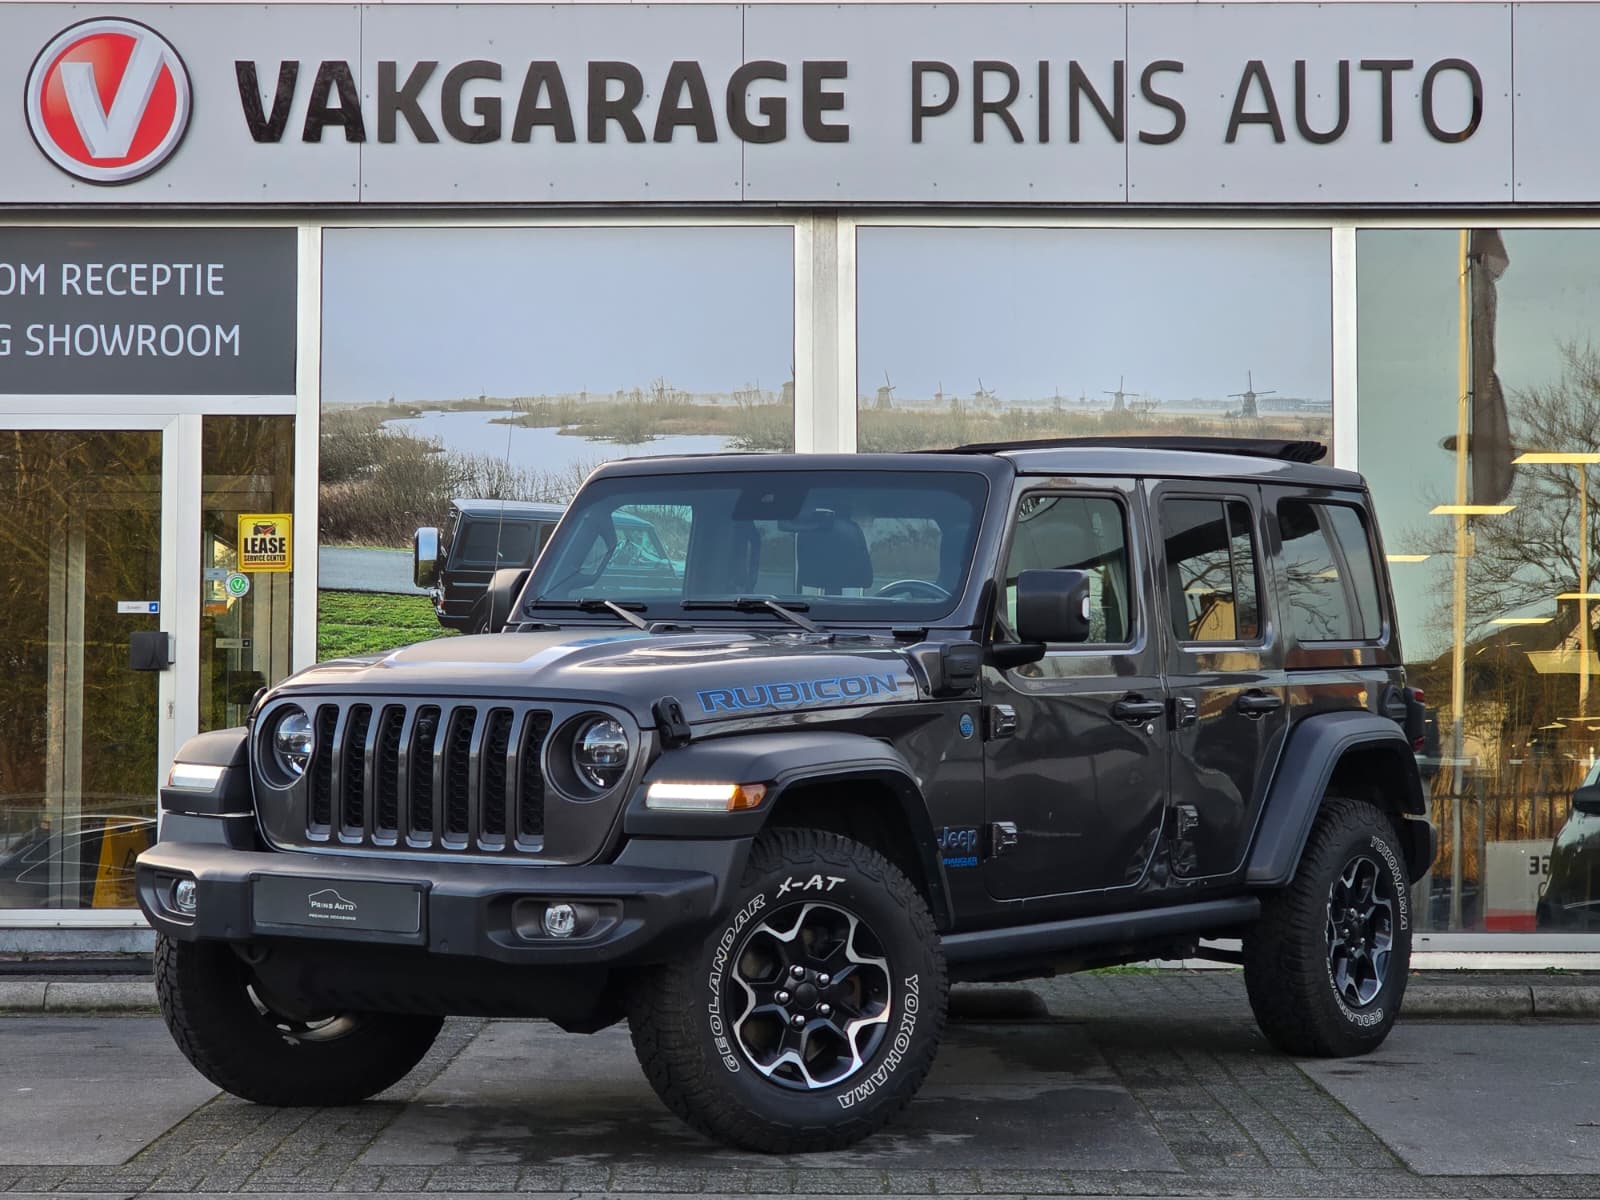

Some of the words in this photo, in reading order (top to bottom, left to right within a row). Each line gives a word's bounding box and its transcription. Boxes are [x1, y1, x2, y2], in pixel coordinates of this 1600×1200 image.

[234, 59, 850, 143] VAKGARAGE
[911, 59, 1187, 144] PRINS
[1224, 58, 1484, 144] AUTO
[61, 263, 225, 296] RECEPTIE
[25, 323, 241, 357] SHOWROOM
[243, 537, 286, 554] LEASE
[243, 554, 265, 562] SERVICE
[697, 672, 899, 713] RUBICON
[936, 825, 977, 852] Jeep
[708, 893, 766, 1073] GEOLANDAR
[776, 874, 847, 898] X-AT
[837, 974, 919, 1109] YOKOHAMA
